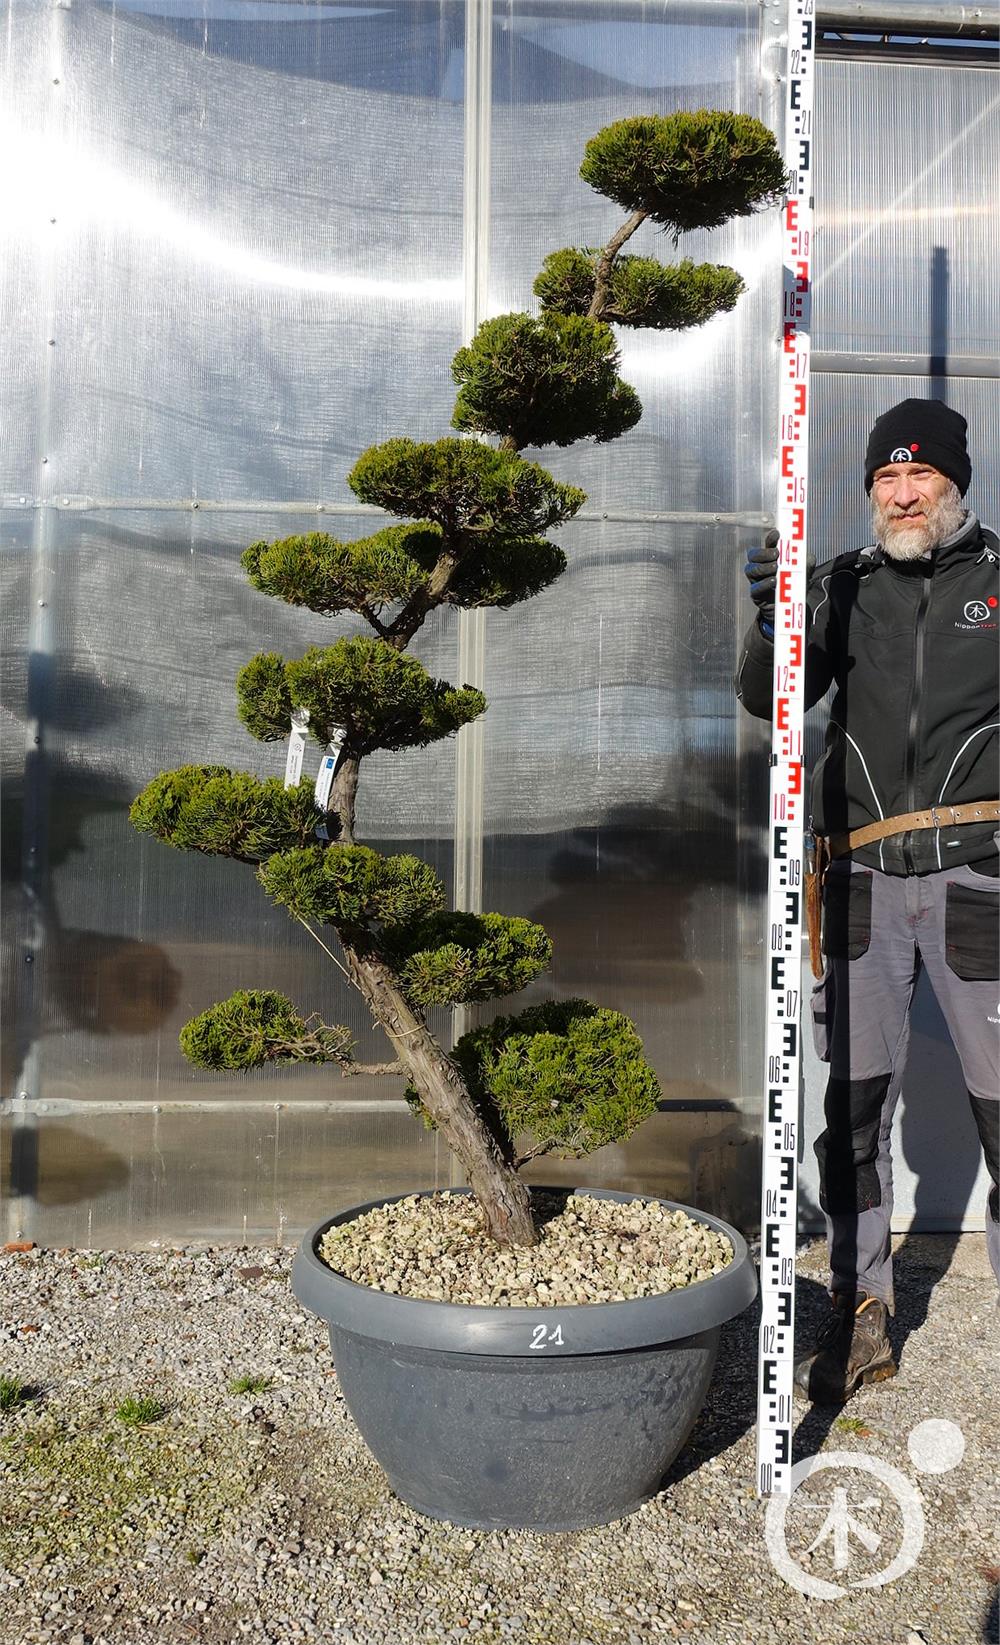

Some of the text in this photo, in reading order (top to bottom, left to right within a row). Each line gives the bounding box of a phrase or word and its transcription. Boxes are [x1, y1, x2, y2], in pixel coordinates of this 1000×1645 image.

[791, 50, 800, 74] 22
[802, 110, 811, 134] 21
[798, 231, 809, 256] 19
[784, 291, 795, 317] 18
[796, 353, 807, 378] 17
[782, 414, 793, 440] 16
[794, 477, 805, 503] 15
[780, 539, 790, 565] 14
[792, 603, 803, 629] 13
[777, 666, 788, 692] 12
[790, 730, 801, 756] 11
[774, 793, 786, 820] 10
[789, 859, 800, 886] 09
[771, 923, 782, 950] 08
[787, 990, 798, 1017] 07
[769, 1055, 780, 1083] 06
[784, 1123, 795, 1150] 05
[766, 1189, 777, 1217] 04
[781, 1258, 792, 1285] 03
[529, 1324, 565, 1349] 21
[763, 1325, 775, 1353] 02
[779, 1394, 790, 1423] 01
[760, 1463, 772, 1492] 00
